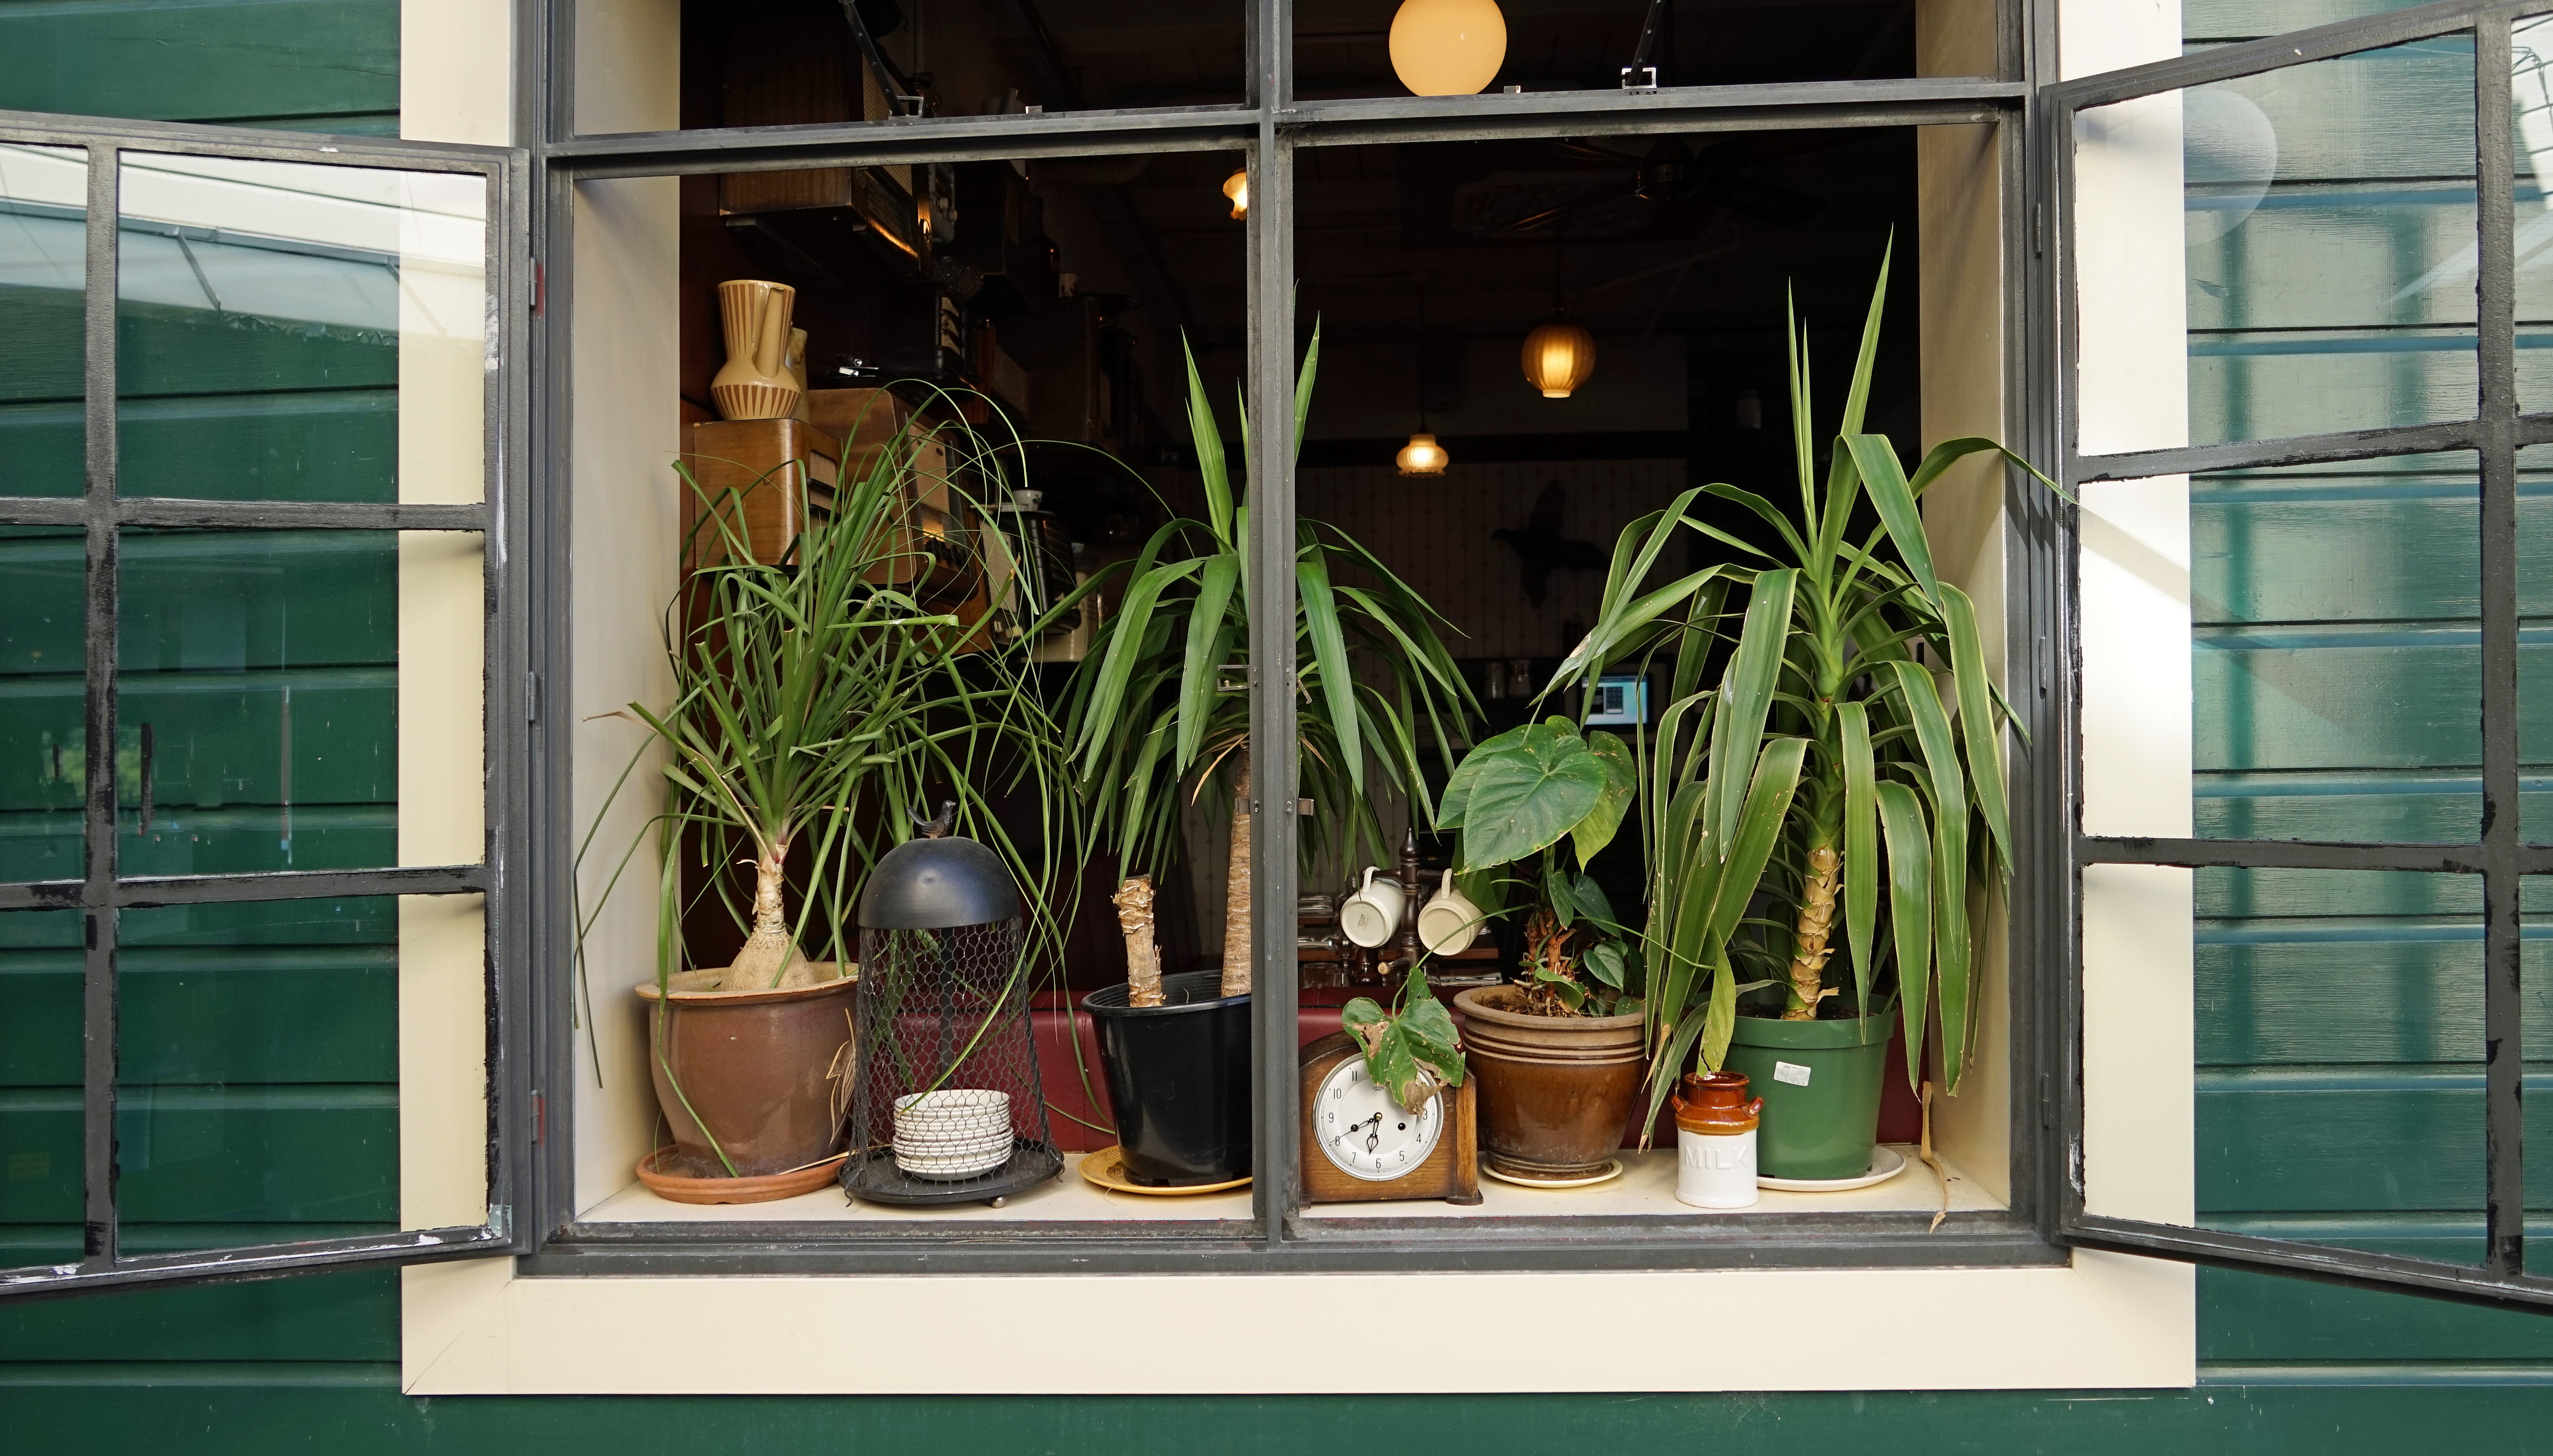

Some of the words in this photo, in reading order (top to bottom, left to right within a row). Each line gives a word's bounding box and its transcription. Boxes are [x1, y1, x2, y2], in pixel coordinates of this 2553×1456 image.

[1352, 1070, 1358, 1082] 11
[1333, 1088, 1341, 1099] 10
[1329, 1112, 1334, 1123] 9
[1422, 1109, 1428, 1120] 3
[1335, 1135, 1340, 1146] 8
[1416, 1133, 1421, 1143] 4
[1352, 1152, 1356, 1163] 7
[1399, 1151, 1405, 1162] 5
[1685, 1145, 1749, 1169] MILK
[1376, 1158, 1381, 1169] 6
